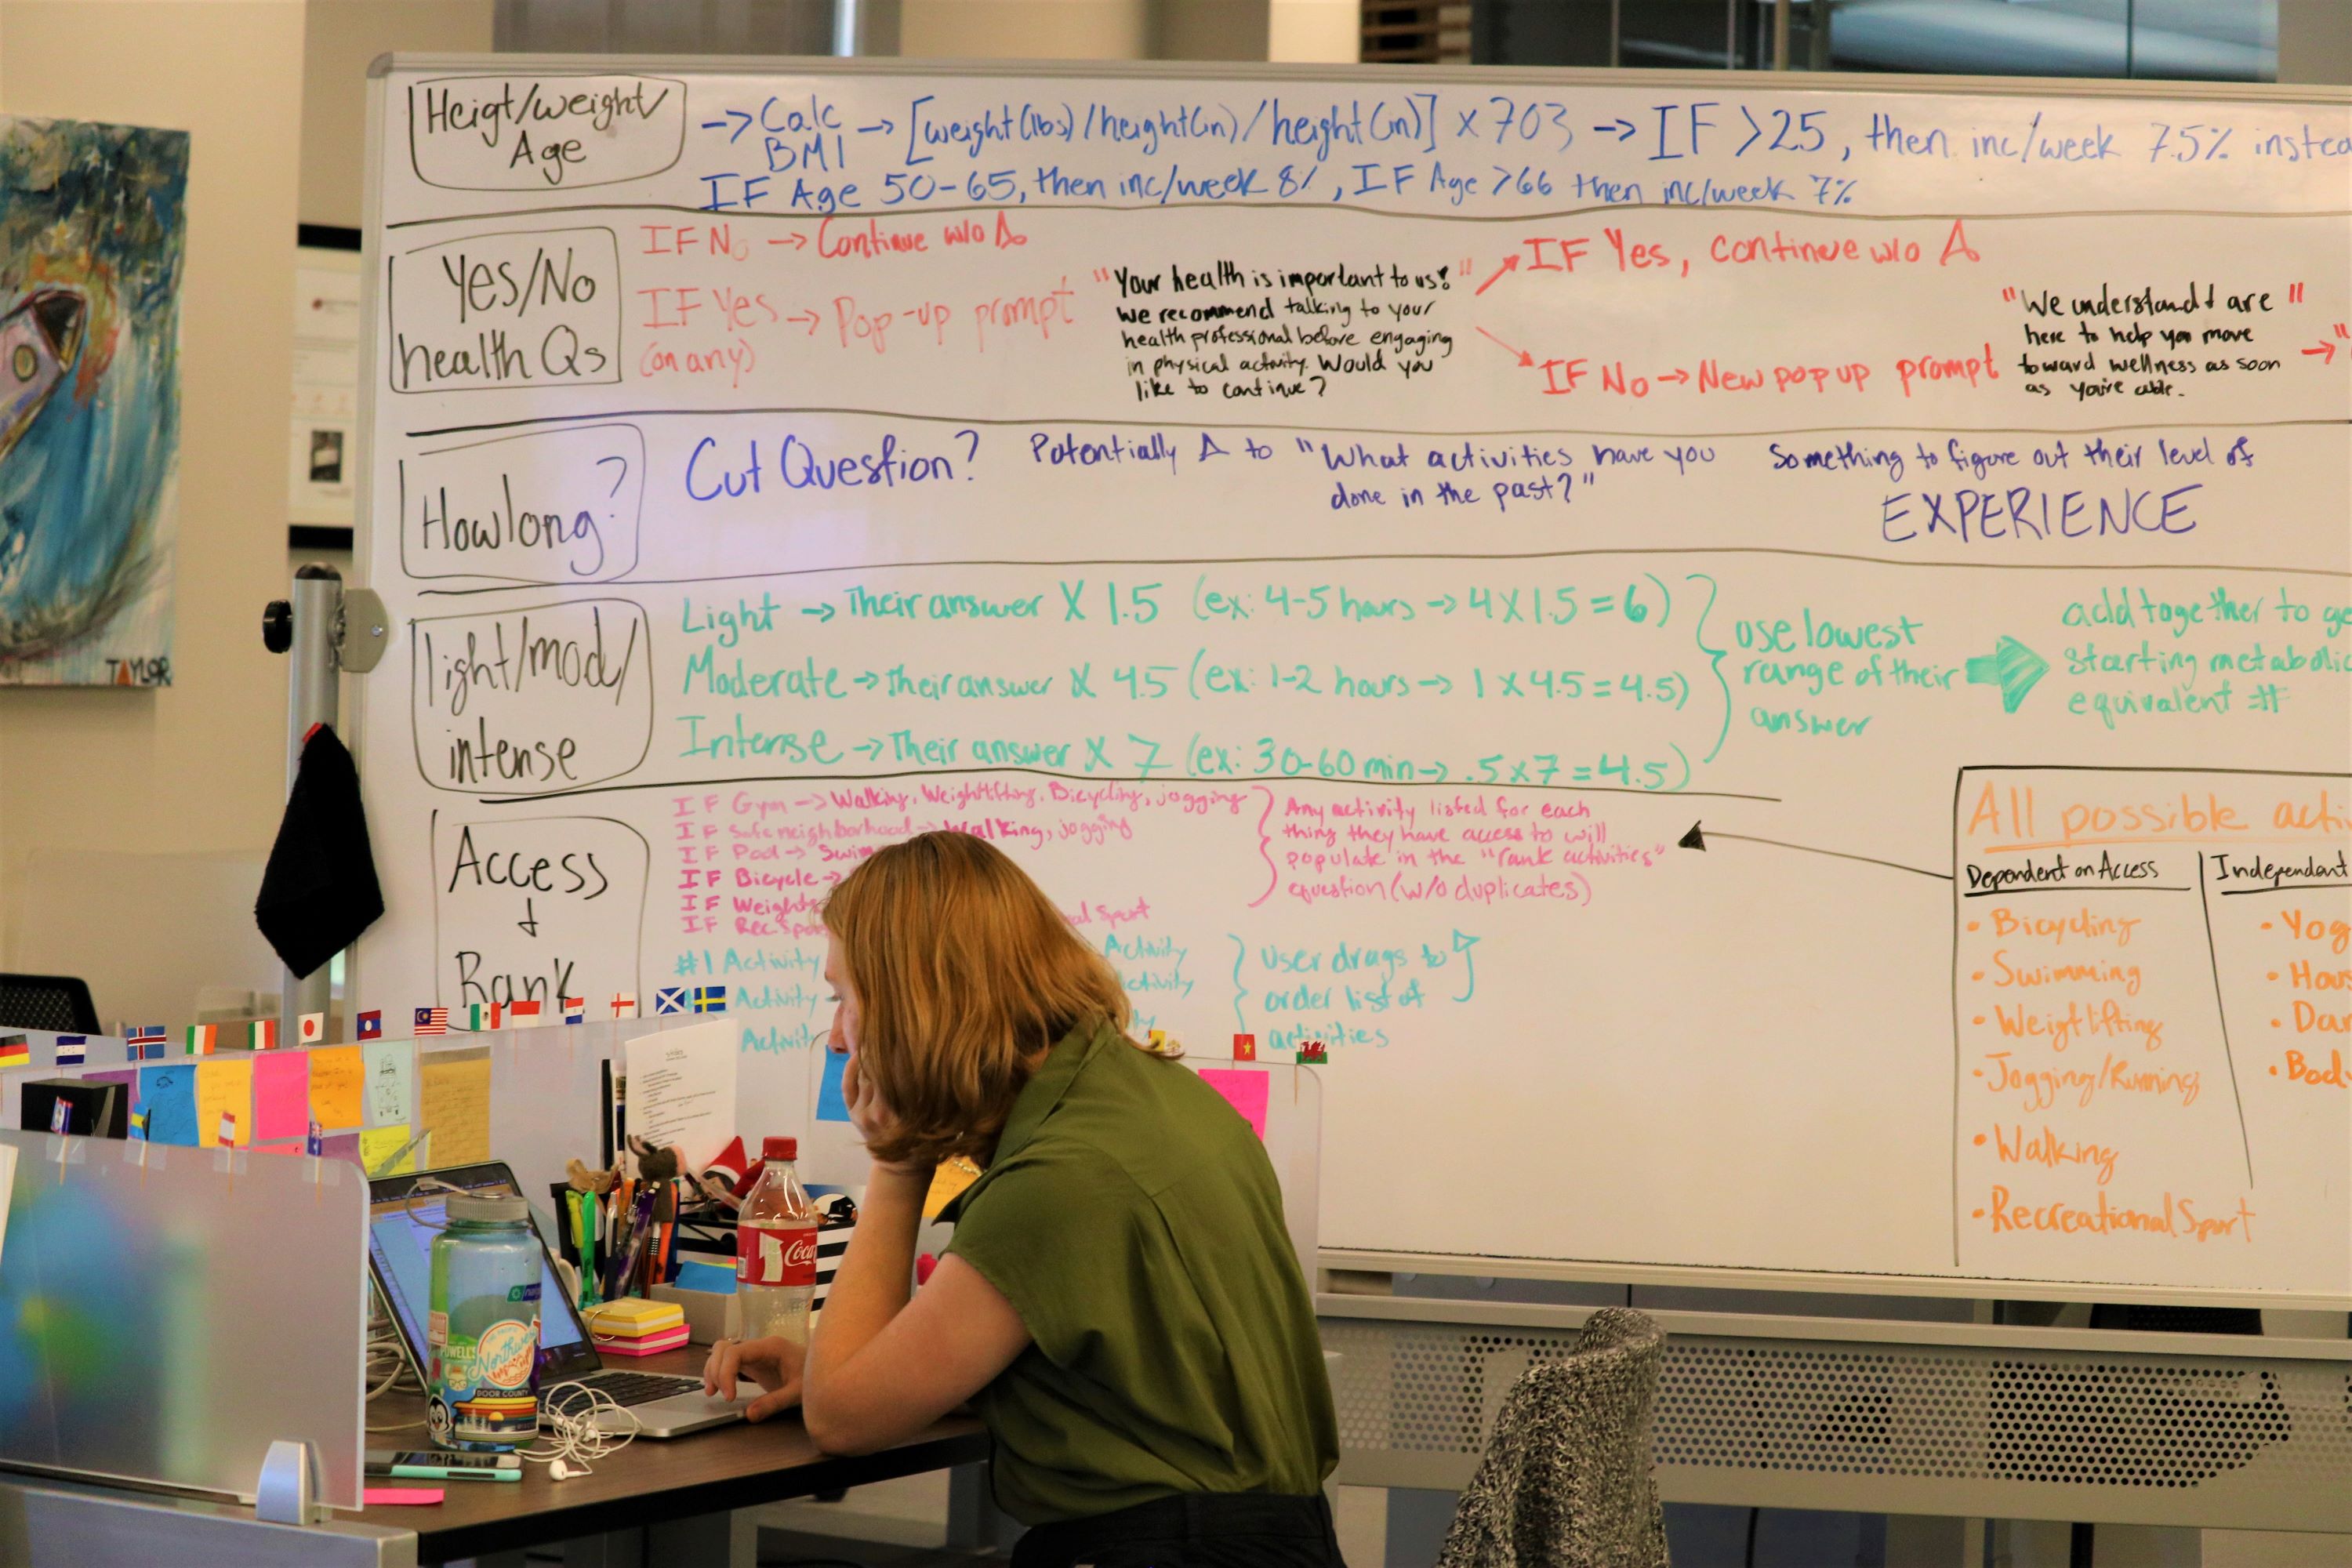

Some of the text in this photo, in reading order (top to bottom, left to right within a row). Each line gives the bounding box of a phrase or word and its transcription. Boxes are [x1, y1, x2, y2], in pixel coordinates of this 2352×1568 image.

[761, 94, 842, 132] Calc
[1490, 96, 1573, 152] 703
[1649, 103, 1720, 160] IF
[1865, 112, 1949, 157] then
[2255, 123, 2352, 162] instea
[510, 130, 587, 184] Age
[767, 133, 845, 171] BMI
[699, 173, 769, 212] IF
[790, 176, 862, 214] Age
[1033, 165, 1105, 199] then
[1431, 160, 1478, 205] Age
[1572, 172, 1644, 205] then
[1809, 175, 1859, 205] 7%
[640, 225, 699, 256] IF
[817, 216, 929, 261] Continue
[1523, 237, 1591, 273] IF
[1173, 260, 1410, 292] health is important to
[637, 286, 699, 328] IF
[713, 286, 779, 332] Yes
[974, 272, 1075, 353] prompt
[1160, 295, 1436, 329] recommend talking to your
[2227, 289, 2274, 313] are
[1121, 324, 1454, 360] health professional before engaging
[2024, 321, 2255, 350] here to help you move
[398, 324, 607, 390] health Qs
[1127, 353, 1433, 384] in physical Would you
[1539, 342, 2000, 399] IF No New prompt
[2018, 352, 2281, 376] toward wellness as soon
[1135, 375, 1329, 402] like continue?
[685, 428, 981, 501] Cut Question?
[1029, 431, 1716, 476] Potentially activities have you
[1769, 436, 2255, 482] Something to figure out their level of
[1331, 480, 1481, 511] done in the
[1882, 483, 2204, 543] EXPERIENCE
[681, 592, 783, 648] Light
[844, 585, 919, 619] Their
[928, 590, 1044, 622] answer
[1339, 586, 1417, 622] hours
[1804, 606, 1925, 649] lowest
[2061, 585, 2310, 639] add together to
[105, 655, 172, 687] TAYLOR
[682, 644, 850, 698] Moderate
[956, 672, 1054, 699] answer
[1334, 662, 1411, 698] hours
[1743, 653, 1960, 695] range of their
[1749, 706, 1874, 737] answer
[2067, 678, 2233, 731] equivalent
[446, 715, 579, 784] intense
[675, 714, 845, 766] Intense
[971, 735, 1073, 769] answer
[1363, 742, 1412, 782] min
[731, 789, 789, 821] Gym
[1156, 784, 1249, 815] jogging
[1284, 793, 1591, 829] Any activity listed for each
[1967, 780, 2250, 849] All possible
[1058, 814, 1134, 846] jogging
[1281, 822, 1606, 854] thing they access will
[448, 825, 609, 901] Access
[677, 866, 819, 891] IF Bicycle
[1286, 844, 1467, 875] populate in the
[2075, 848, 2160, 881] on Access
[680, 894, 721, 912] IF
[1287, 873, 1387, 905] question
[2280, 908, 2352, 955] Yog
[723, 933, 1189, 983] Activity Activity
[1332, 940, 1448, 984] drags to
[455, 950, 575, 1014] Rank
[1263, 982, 1392, 1013] order list
[476, 1388, 528, 1398] DOOR COUNTY
